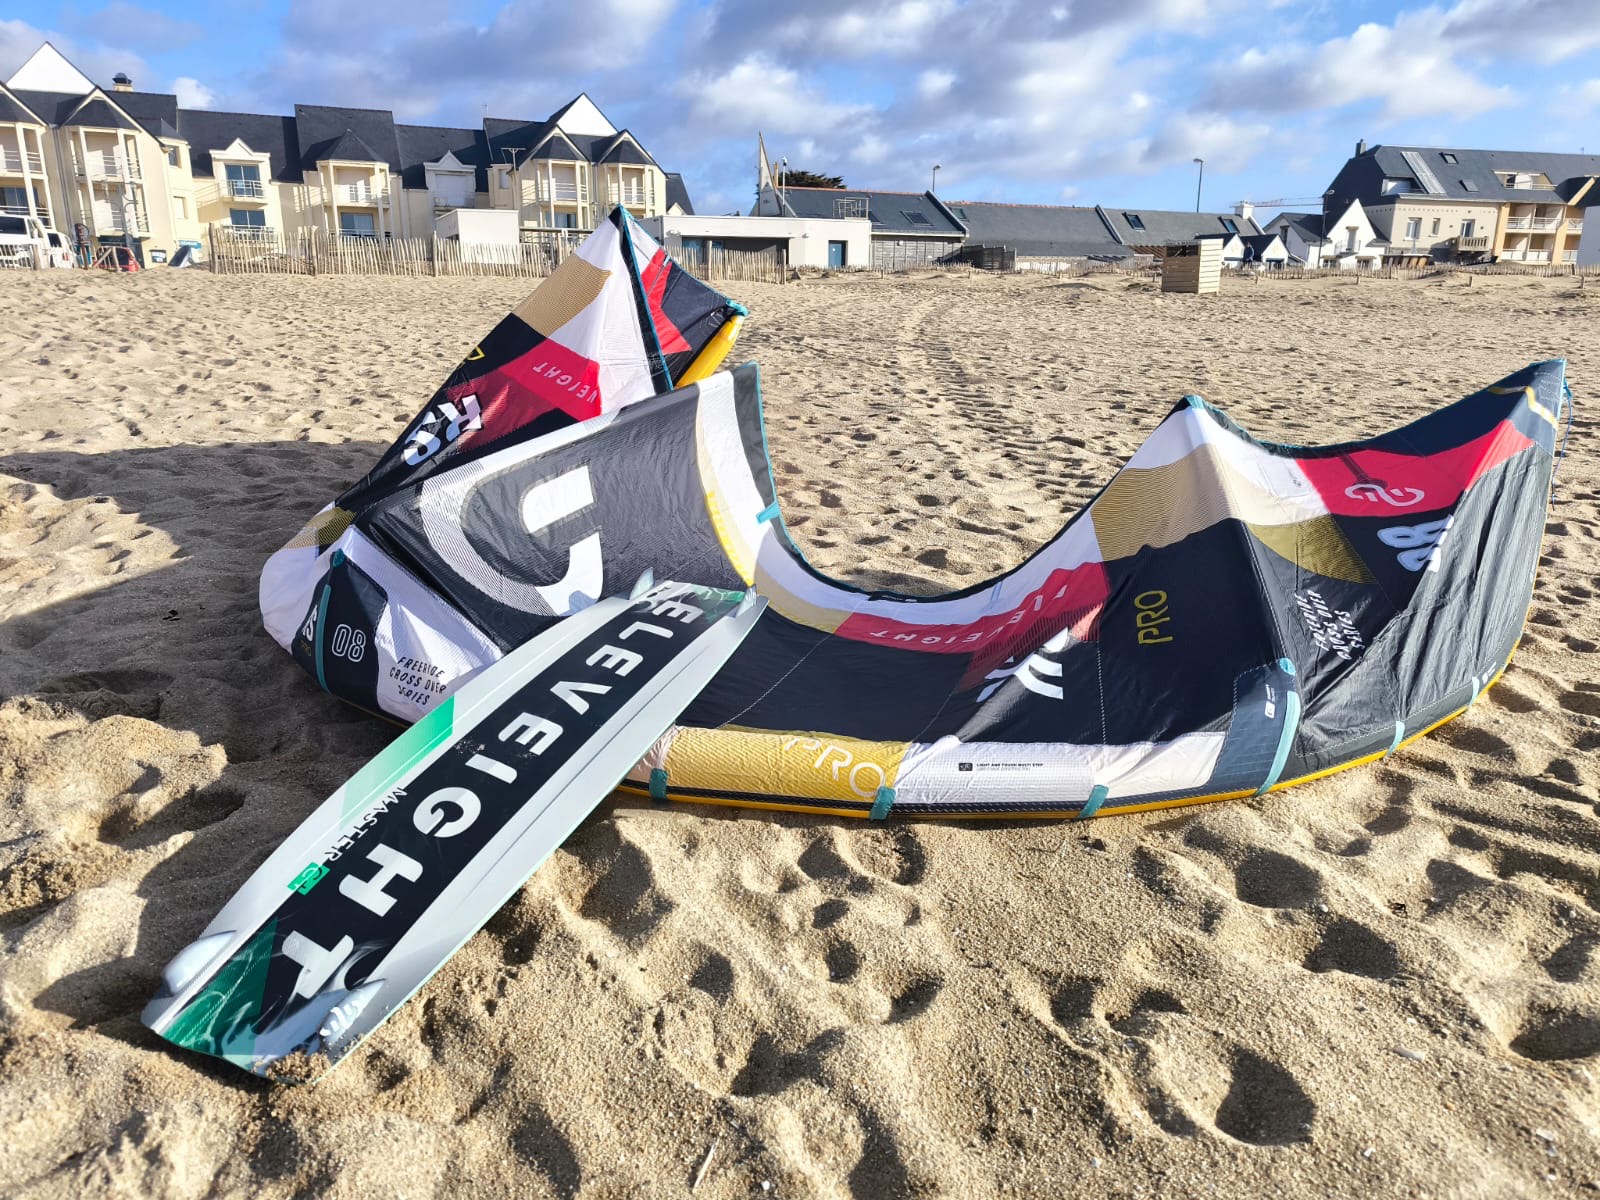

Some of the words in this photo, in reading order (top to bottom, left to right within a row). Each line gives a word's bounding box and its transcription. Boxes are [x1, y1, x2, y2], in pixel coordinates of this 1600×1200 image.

[331, 623, 367, 663] 08
[1133, 589, 1174, 645] PRO
[389, 666, 423, 688] CROSS
[397, 656, 446, 679] FREERIDE
[783, 737, 887, 798] PRO
[280, 599, 705, 1000] ELEVEIGHT
[324, 786, 408, 862] MASTER
